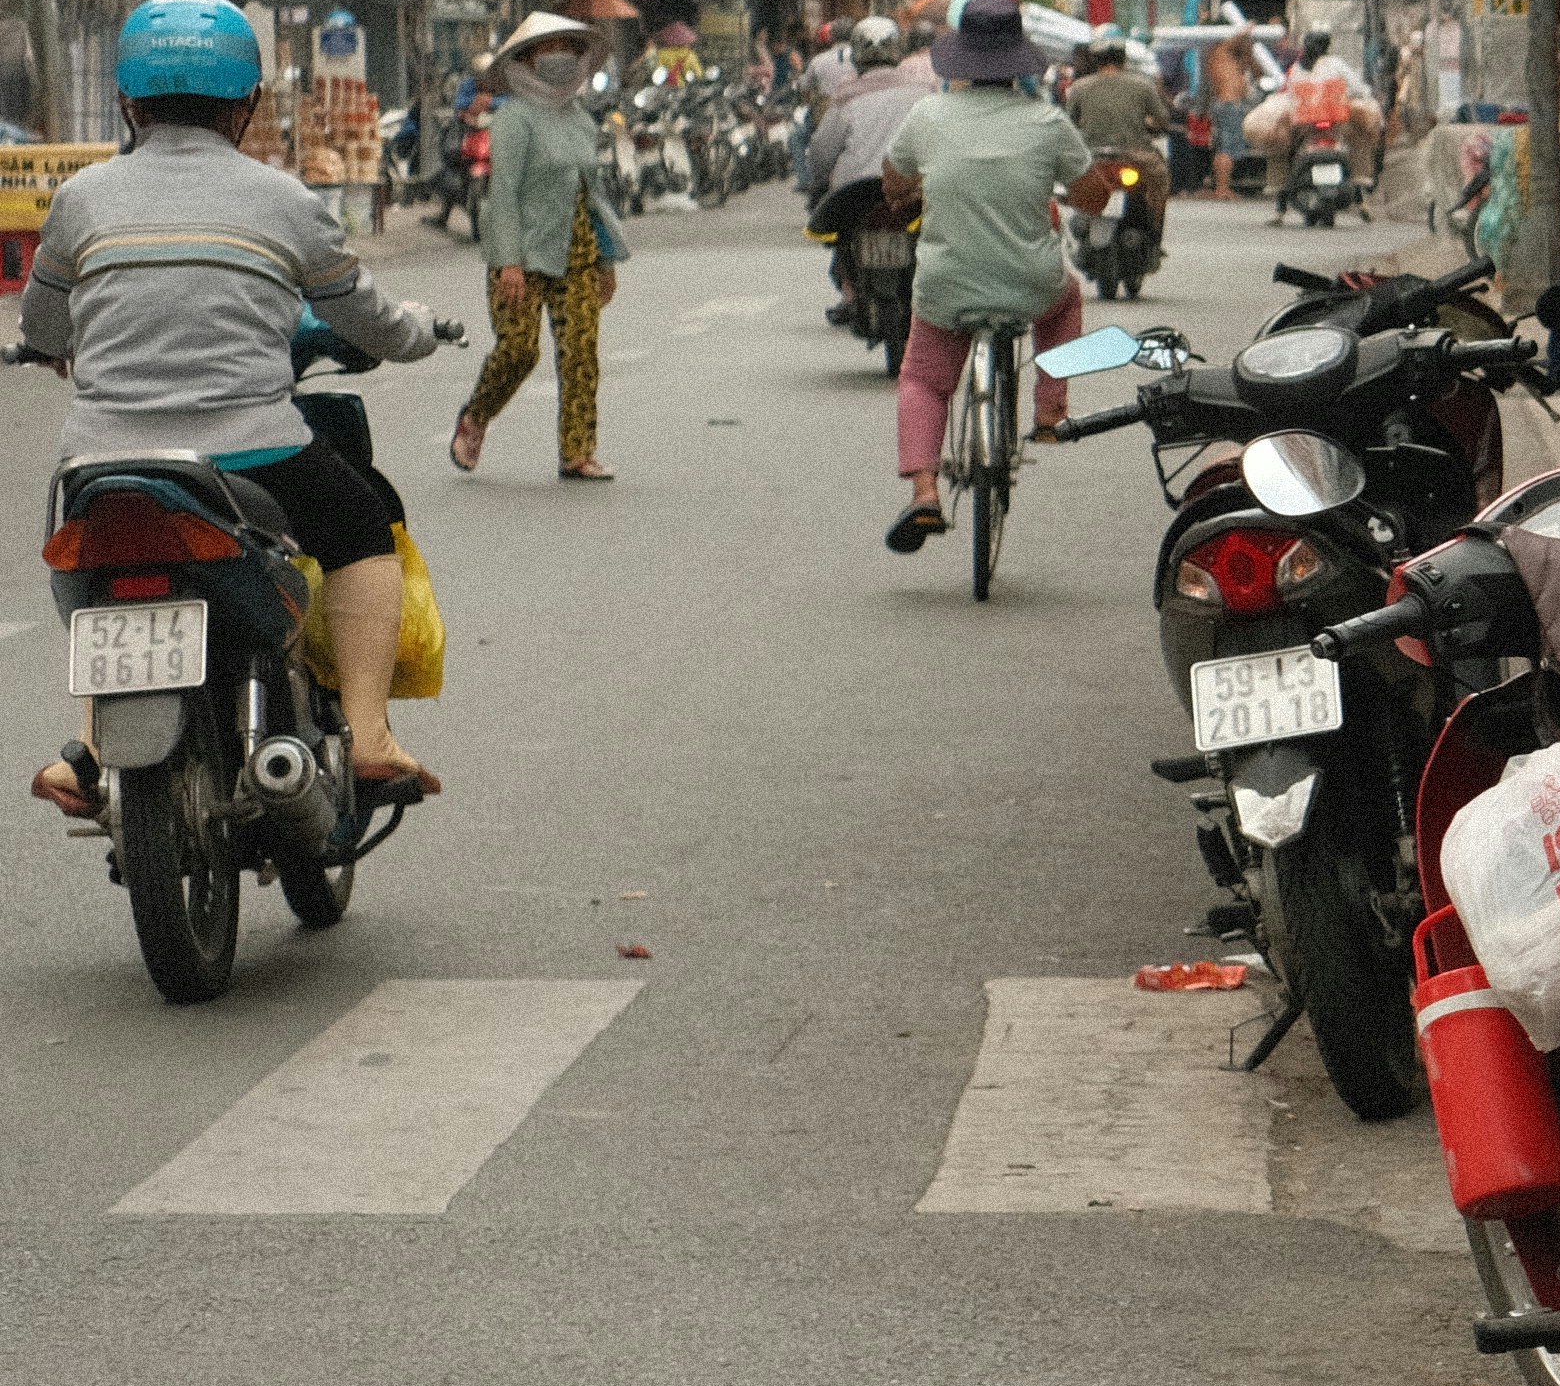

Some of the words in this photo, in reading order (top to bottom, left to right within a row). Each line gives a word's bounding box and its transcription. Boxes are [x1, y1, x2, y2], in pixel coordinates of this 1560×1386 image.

[150, 36, 214, 49] HITACHI
[92, 609, 184, 649] 52-L4
[90, 646, 184, 689] 8619
[1214, 652, 1316, 702] 59-L3
[1208, 689, 1330, 743] 201.18
